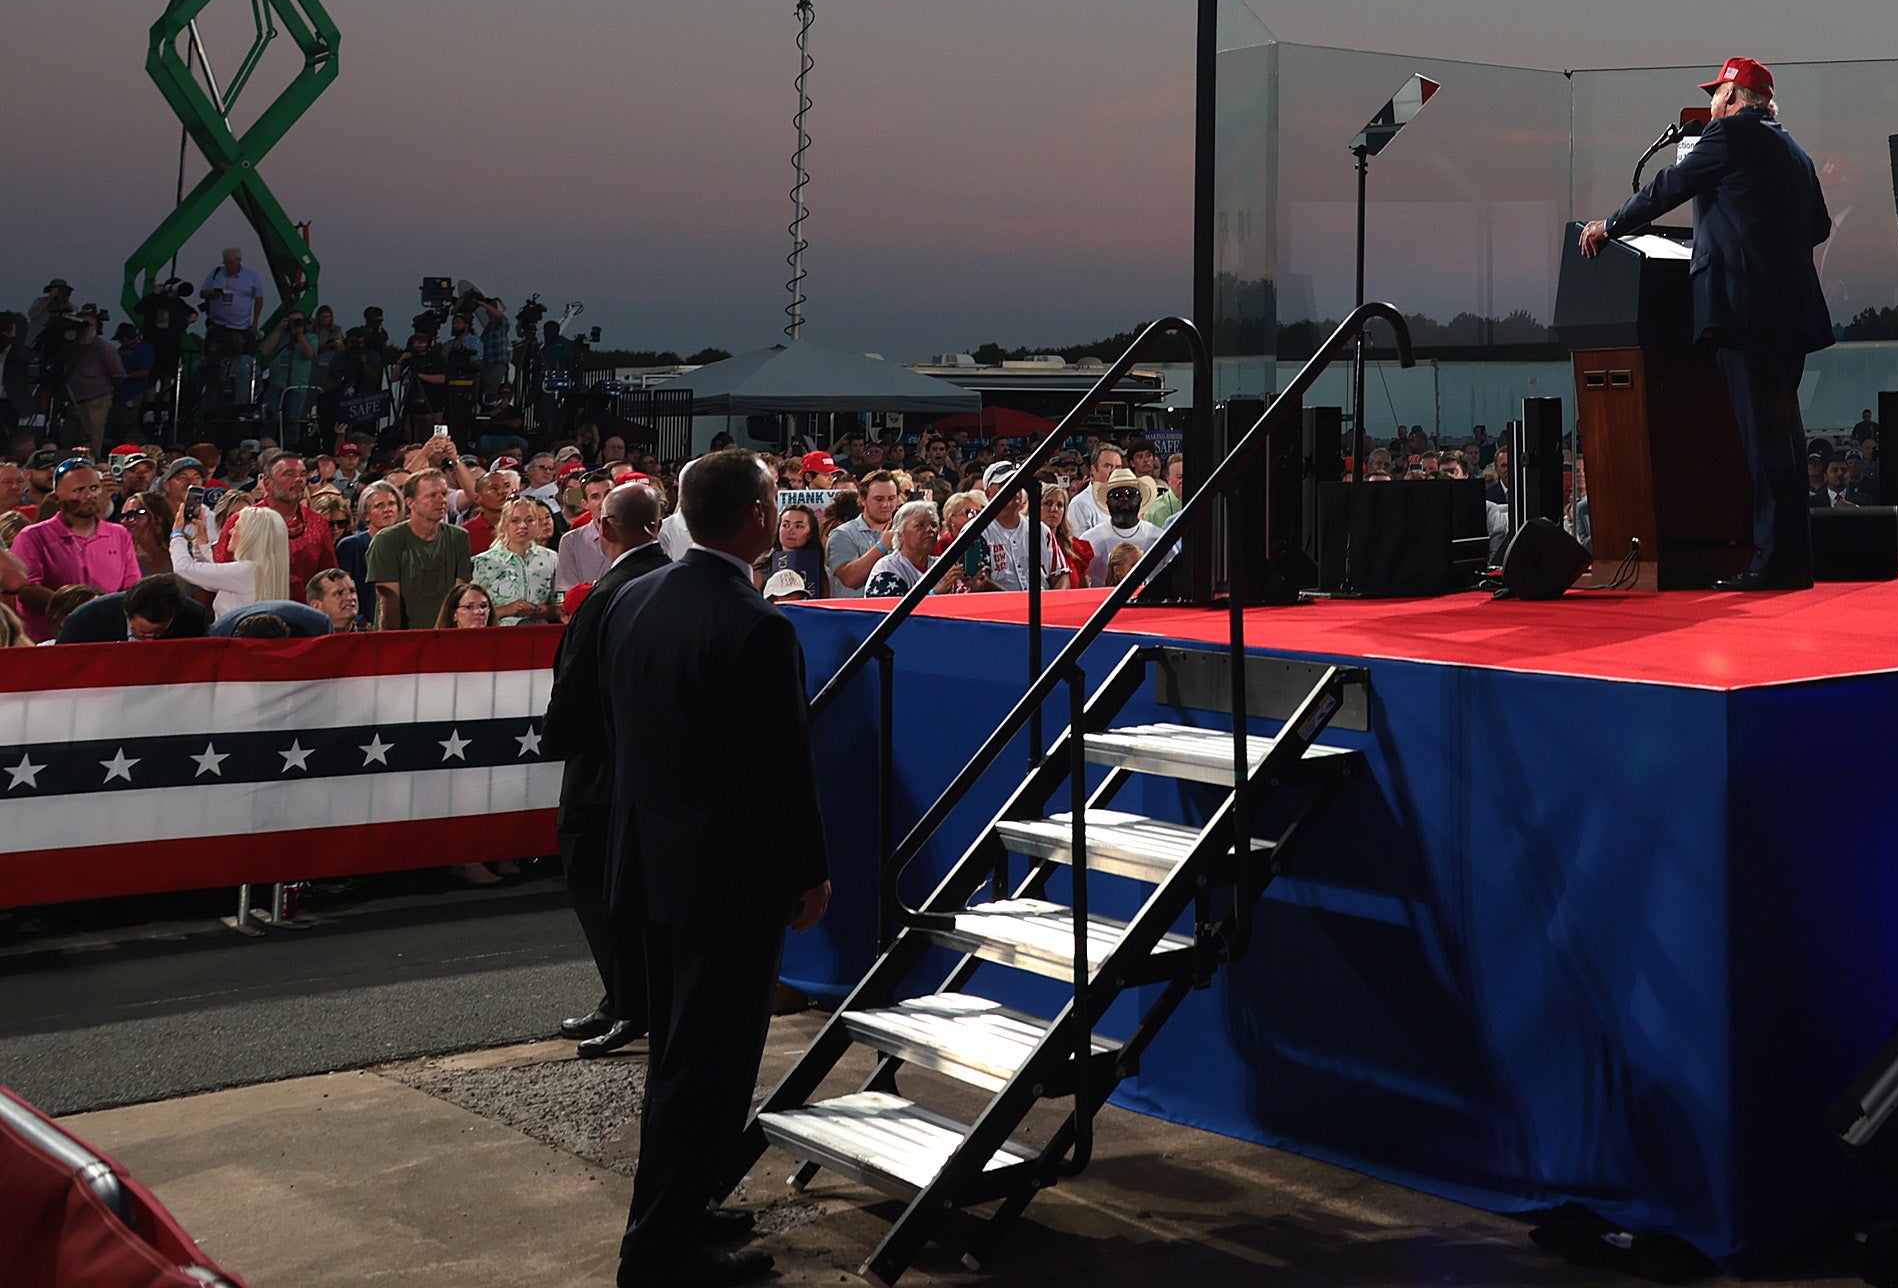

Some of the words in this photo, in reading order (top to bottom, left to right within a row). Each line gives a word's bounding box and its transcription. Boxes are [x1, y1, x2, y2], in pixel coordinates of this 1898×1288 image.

[348, 400, 381, 418] SAFE
[1154, 440, 1180, 453] SAFE
[779, 491, 825, 505] THANK
